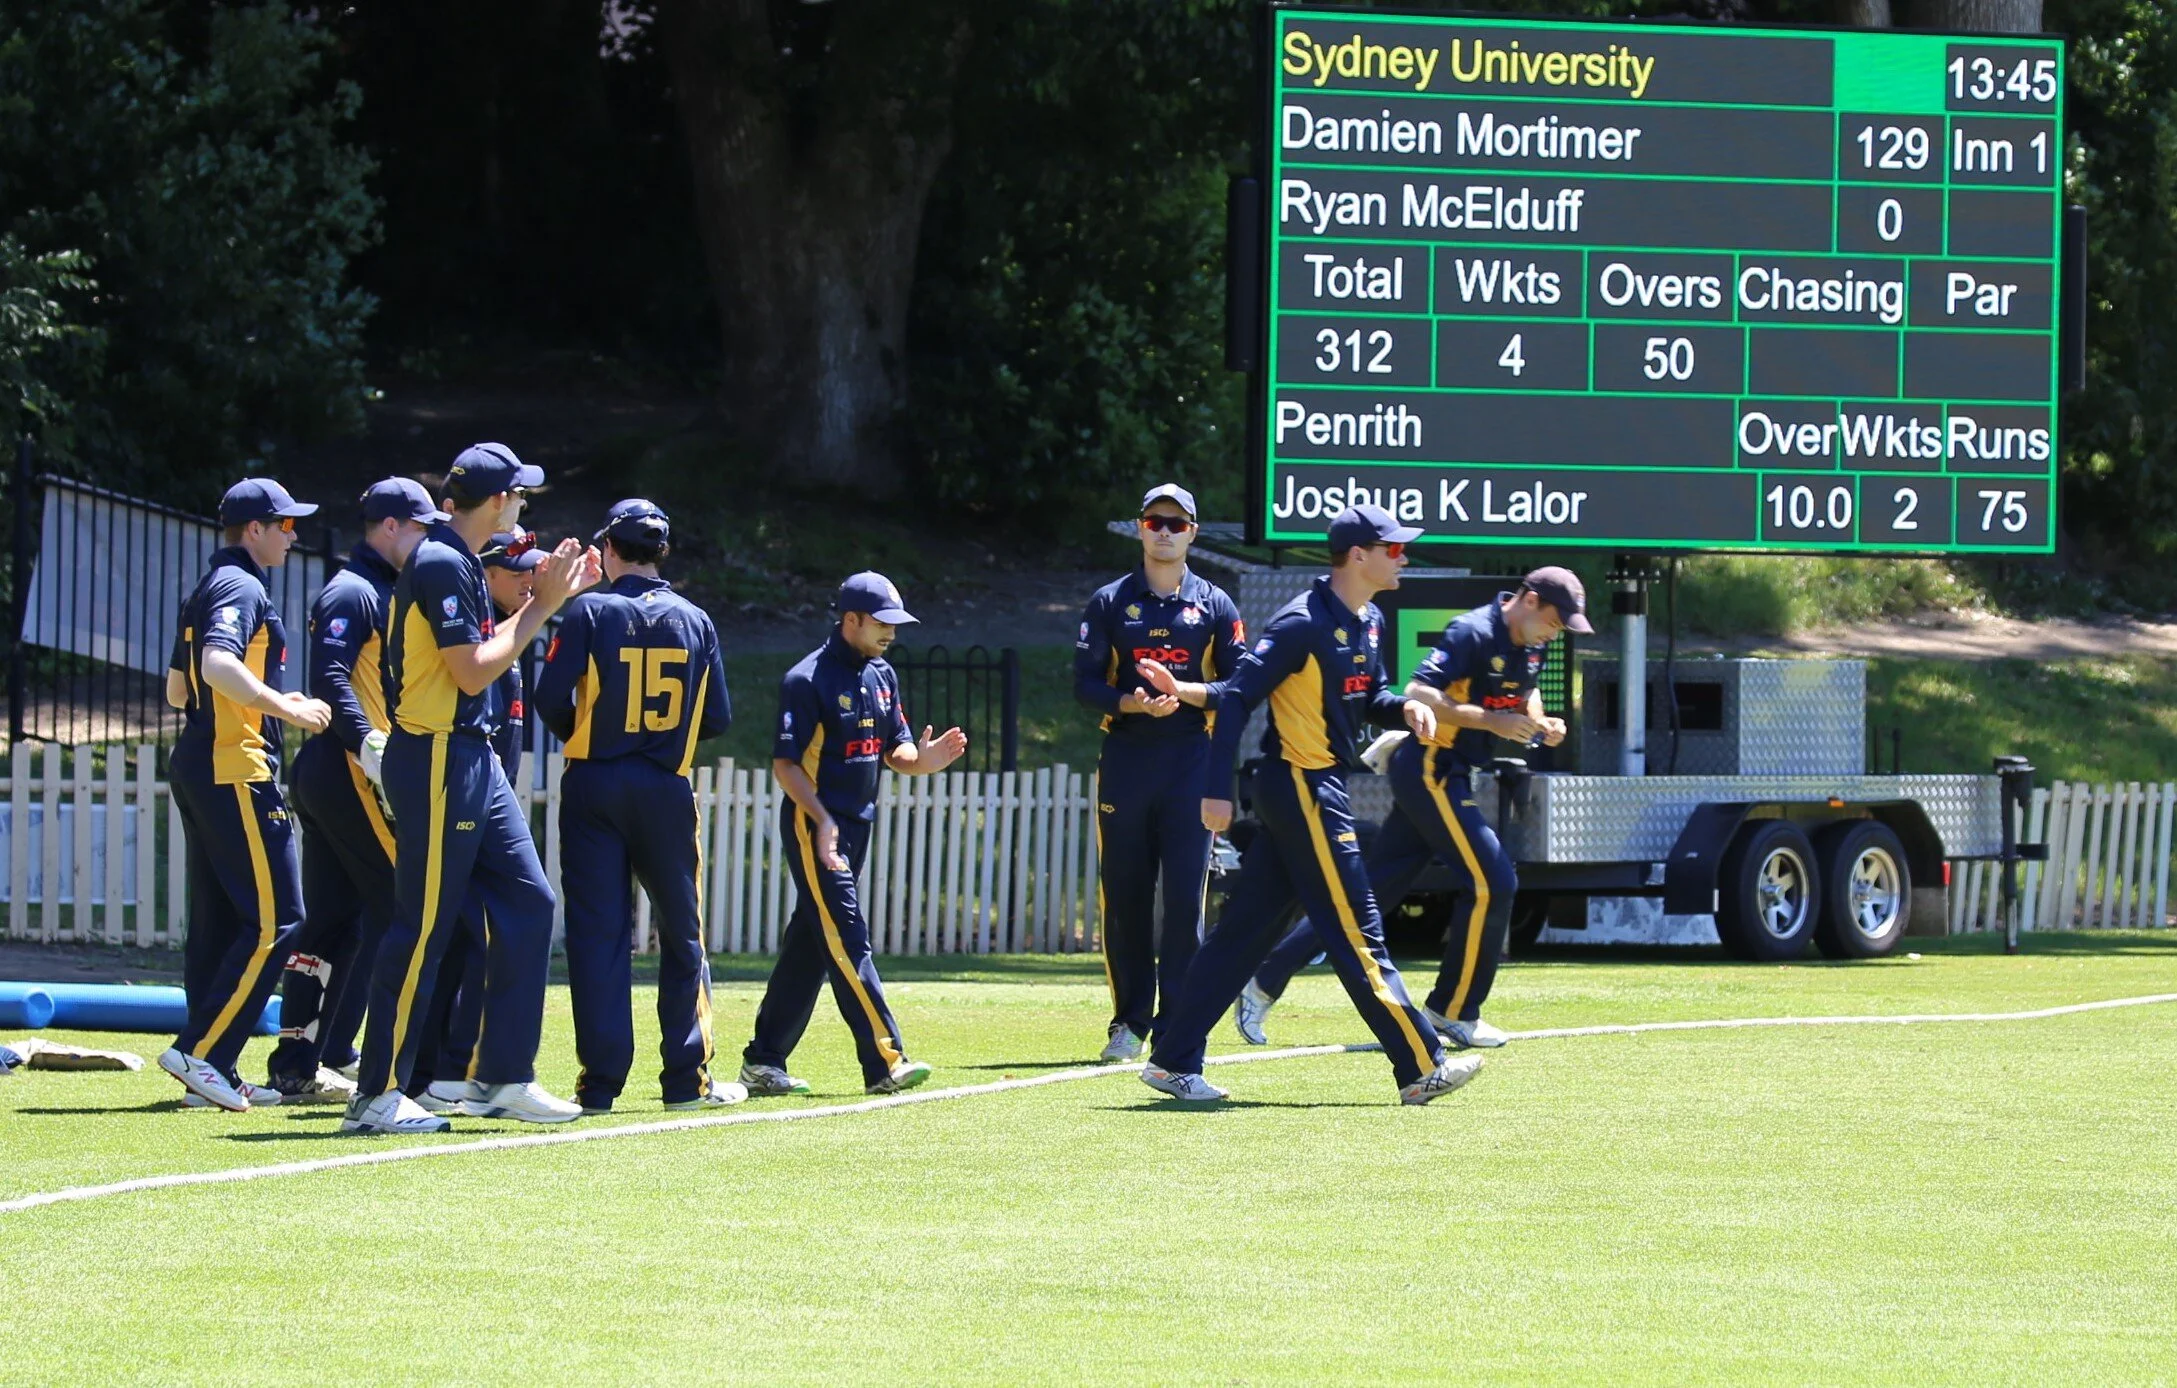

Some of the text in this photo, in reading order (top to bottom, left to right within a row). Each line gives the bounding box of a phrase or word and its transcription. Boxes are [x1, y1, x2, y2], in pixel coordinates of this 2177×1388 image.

[1283, 31, 1655, 99] Sydney University
[1948, 57, 2057, 102] 13:45
[1282, 106, 1642, 161] Damien Mortimer
[1858, 126, 1930, 170] 129
[1953, 129, 2046, 174] Inn 1
[1281, 180, 1585, 235] Ryan McElduff
[1877, 198, 1903, 241] 0
[1304, 254, 1403, 300] Total
[1455, 259, 1561, 304] Wkts
[1599, 262, 1722, 309] Overs
[1738, 266, 1904, 323] Chasing
[1946, 273, 2018, 316] Par
[1315, 328, 1393, 374] 312
[1498, 333, 1526, 377] 4
[1643, 337, 1695, 381] 50
[1276, 401, 1422, 448] Penrith
[1738, 412, 1838, 456] Over
[1839, 414, 1943, 459] Wkts
[1947, 417, 2050, 461] Runs
[1272, 475, 1588, 524] Joshua K Lalor
[1766, 484, 1852, 529] 10.0
[1892, 487, 1918, 530] 2
[1978, 490, 2028, 532] 75
[1132, 647, 1190, 663] FDC
[619, 647, 689, 733] 15
